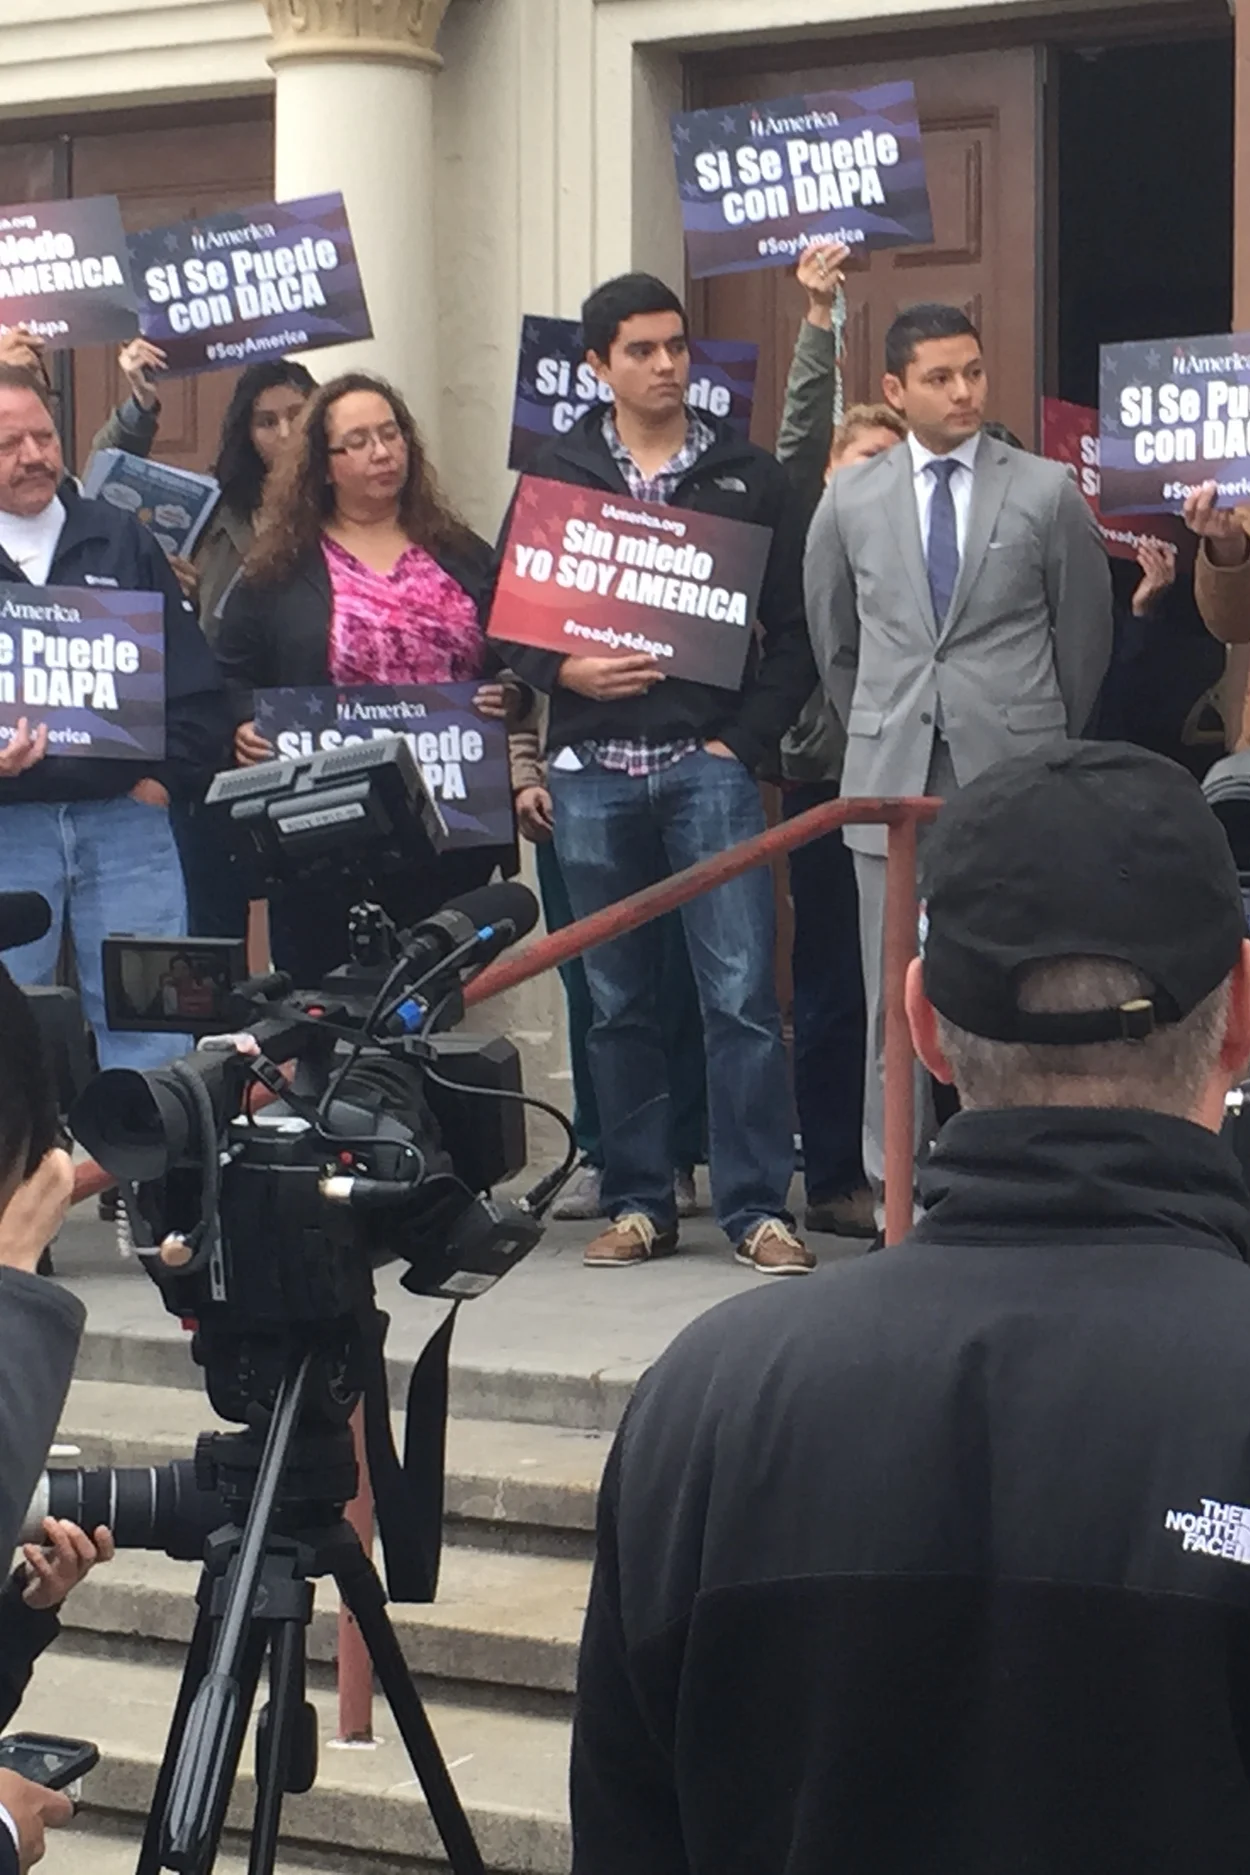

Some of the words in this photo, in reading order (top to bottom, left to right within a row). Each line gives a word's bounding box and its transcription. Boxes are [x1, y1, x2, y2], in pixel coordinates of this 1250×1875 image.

[695, 150, 732, 192] Si
[735, 146, 782, 186] Se
[786, 129, 898, 176] Puede
[722, 185, 789, 225] con
[793, 167, 885, 214] DAPA
[145, 264, 182, 303] Si
[183, 258, 230, 295] Se
[230, 237, 338, 286] Puede
[168, 294, 233, 333] con
[234, 272, 326, 320] DACA
[206, 330, 308, 360] #SoyAmerica
[536, 358, 571, 396] Si
[1120, 386, 1152, 427] Si
[1158, 383, 1201, 424] Se
[1134, 427, 1196, 464] con
[563, 519, 614, 560] Sin
[615, 536, 713, 581] miedo
[515, 544, 554, 582] YO
[555, 554, 617, 596] SOY
[616, 568, 748, 626] AMERICA
[22, 628, 139, 673] Puede
[563, 619, 675, 661] #ready4dapa
[23, 667, 119, 710] DAPA
[1164, 1509, 1239, 1541] NORTH
[1200, 1498, 1243, 1521] THE
[1182, 1532, 1237, 1559] FACE
